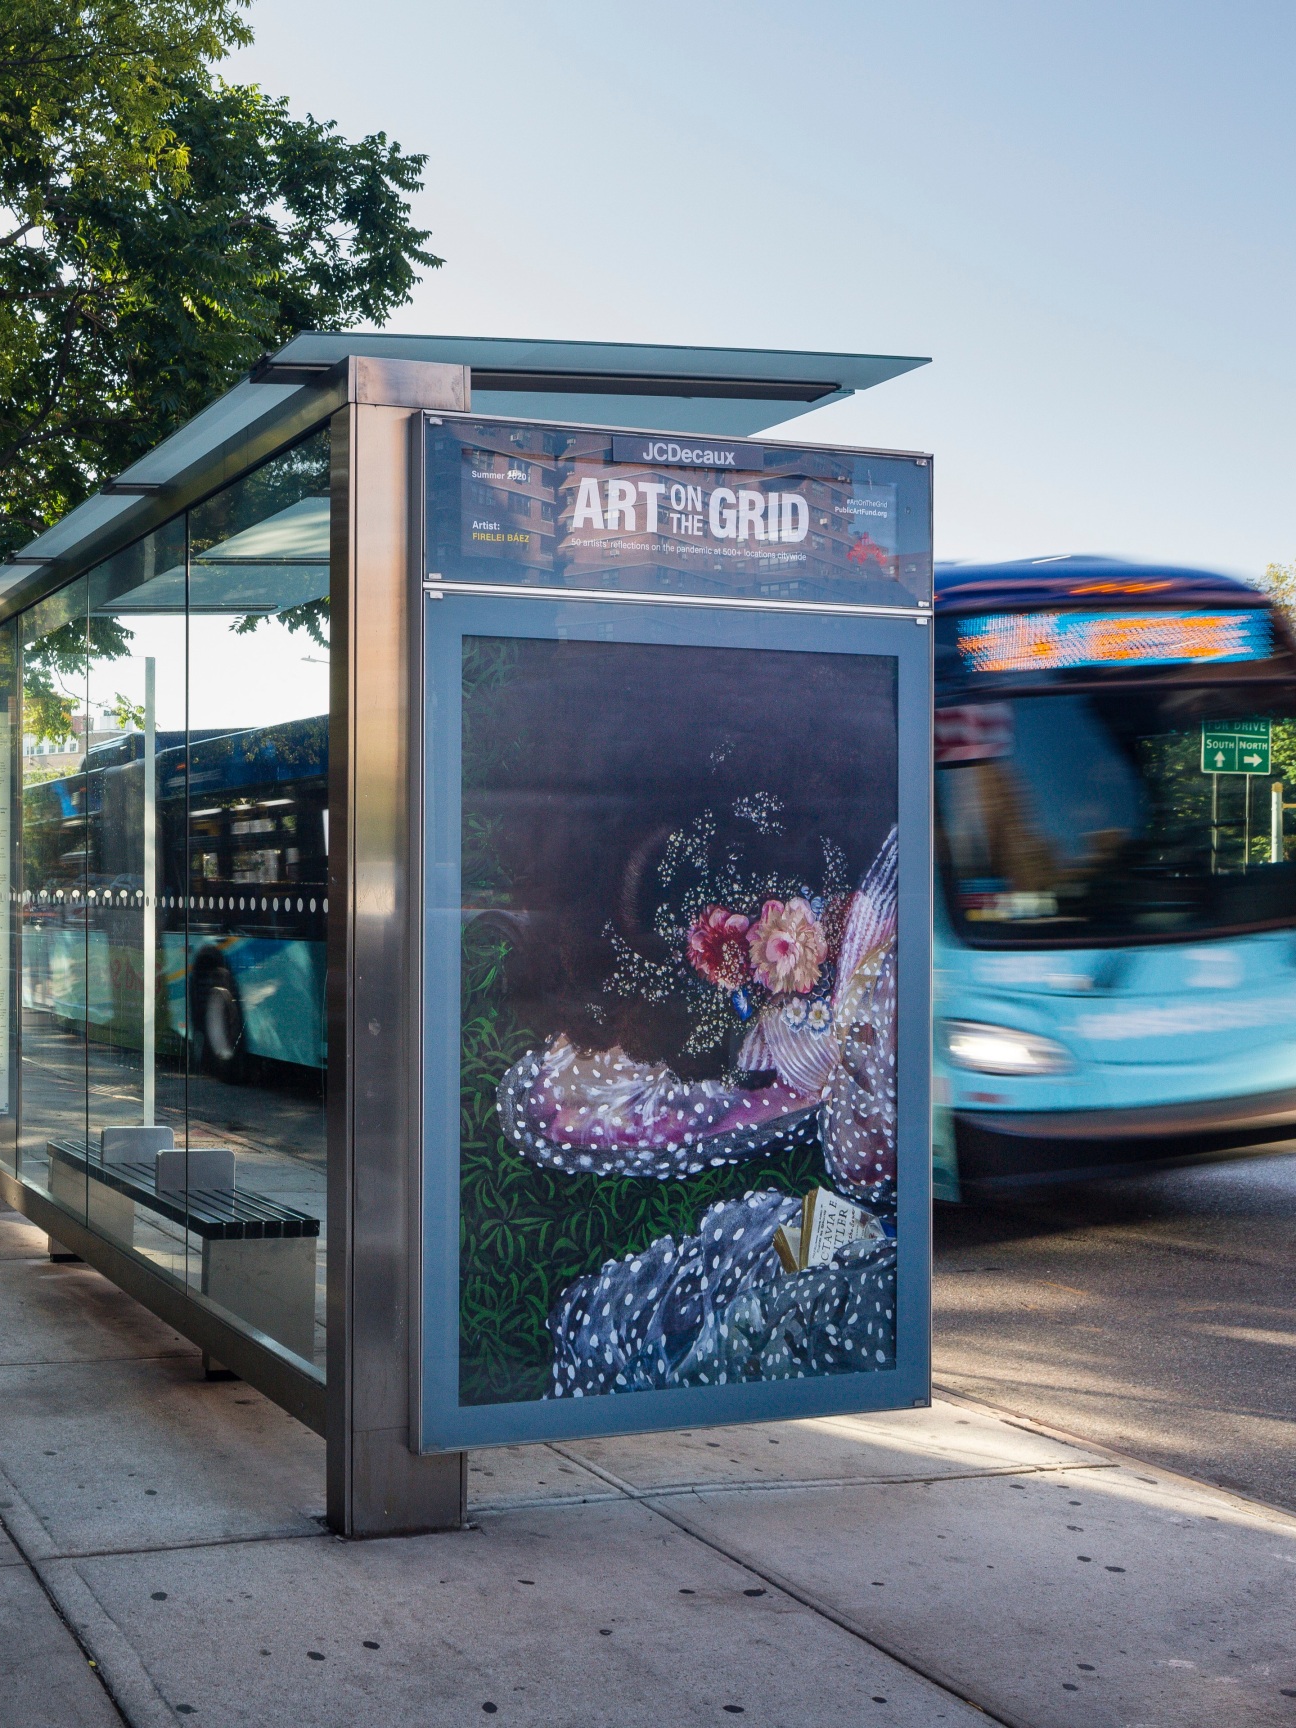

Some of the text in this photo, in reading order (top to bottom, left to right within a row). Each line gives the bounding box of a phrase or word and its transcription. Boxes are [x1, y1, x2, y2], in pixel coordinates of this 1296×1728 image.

[642, 442, 736, 466] JCDecaux
[471, 470, 505, 480] Summer
[670, 483, 702, 512] ON
[572, 477, 666, 533] ART
[709, 487, 810, 543] GRID
[834, 506, 888, 519] PublicArtFund.org
[472, 520, 500, 530] Artist:
[670, 512, 703, 536] THE
[472, 532, 530, 543] FIRELEI BÁEZ
[571, 538, 581, 546] 50
[610, 540, 650, 551] reflections
[663, 543, 675, 552] the
[676, 544, 714, 555] pandemic
[714, 547, 721, 555] at
[722, 547, 742, 556] 500+
[743, 548, 776, 559] locations
[777, 551, 807, 562] citywide
[1234, 722, 1267, 732] DRIVE
[1206, 739, 1235, 749] SOUTH
[1239, 740, 1268, 750] NORTH
